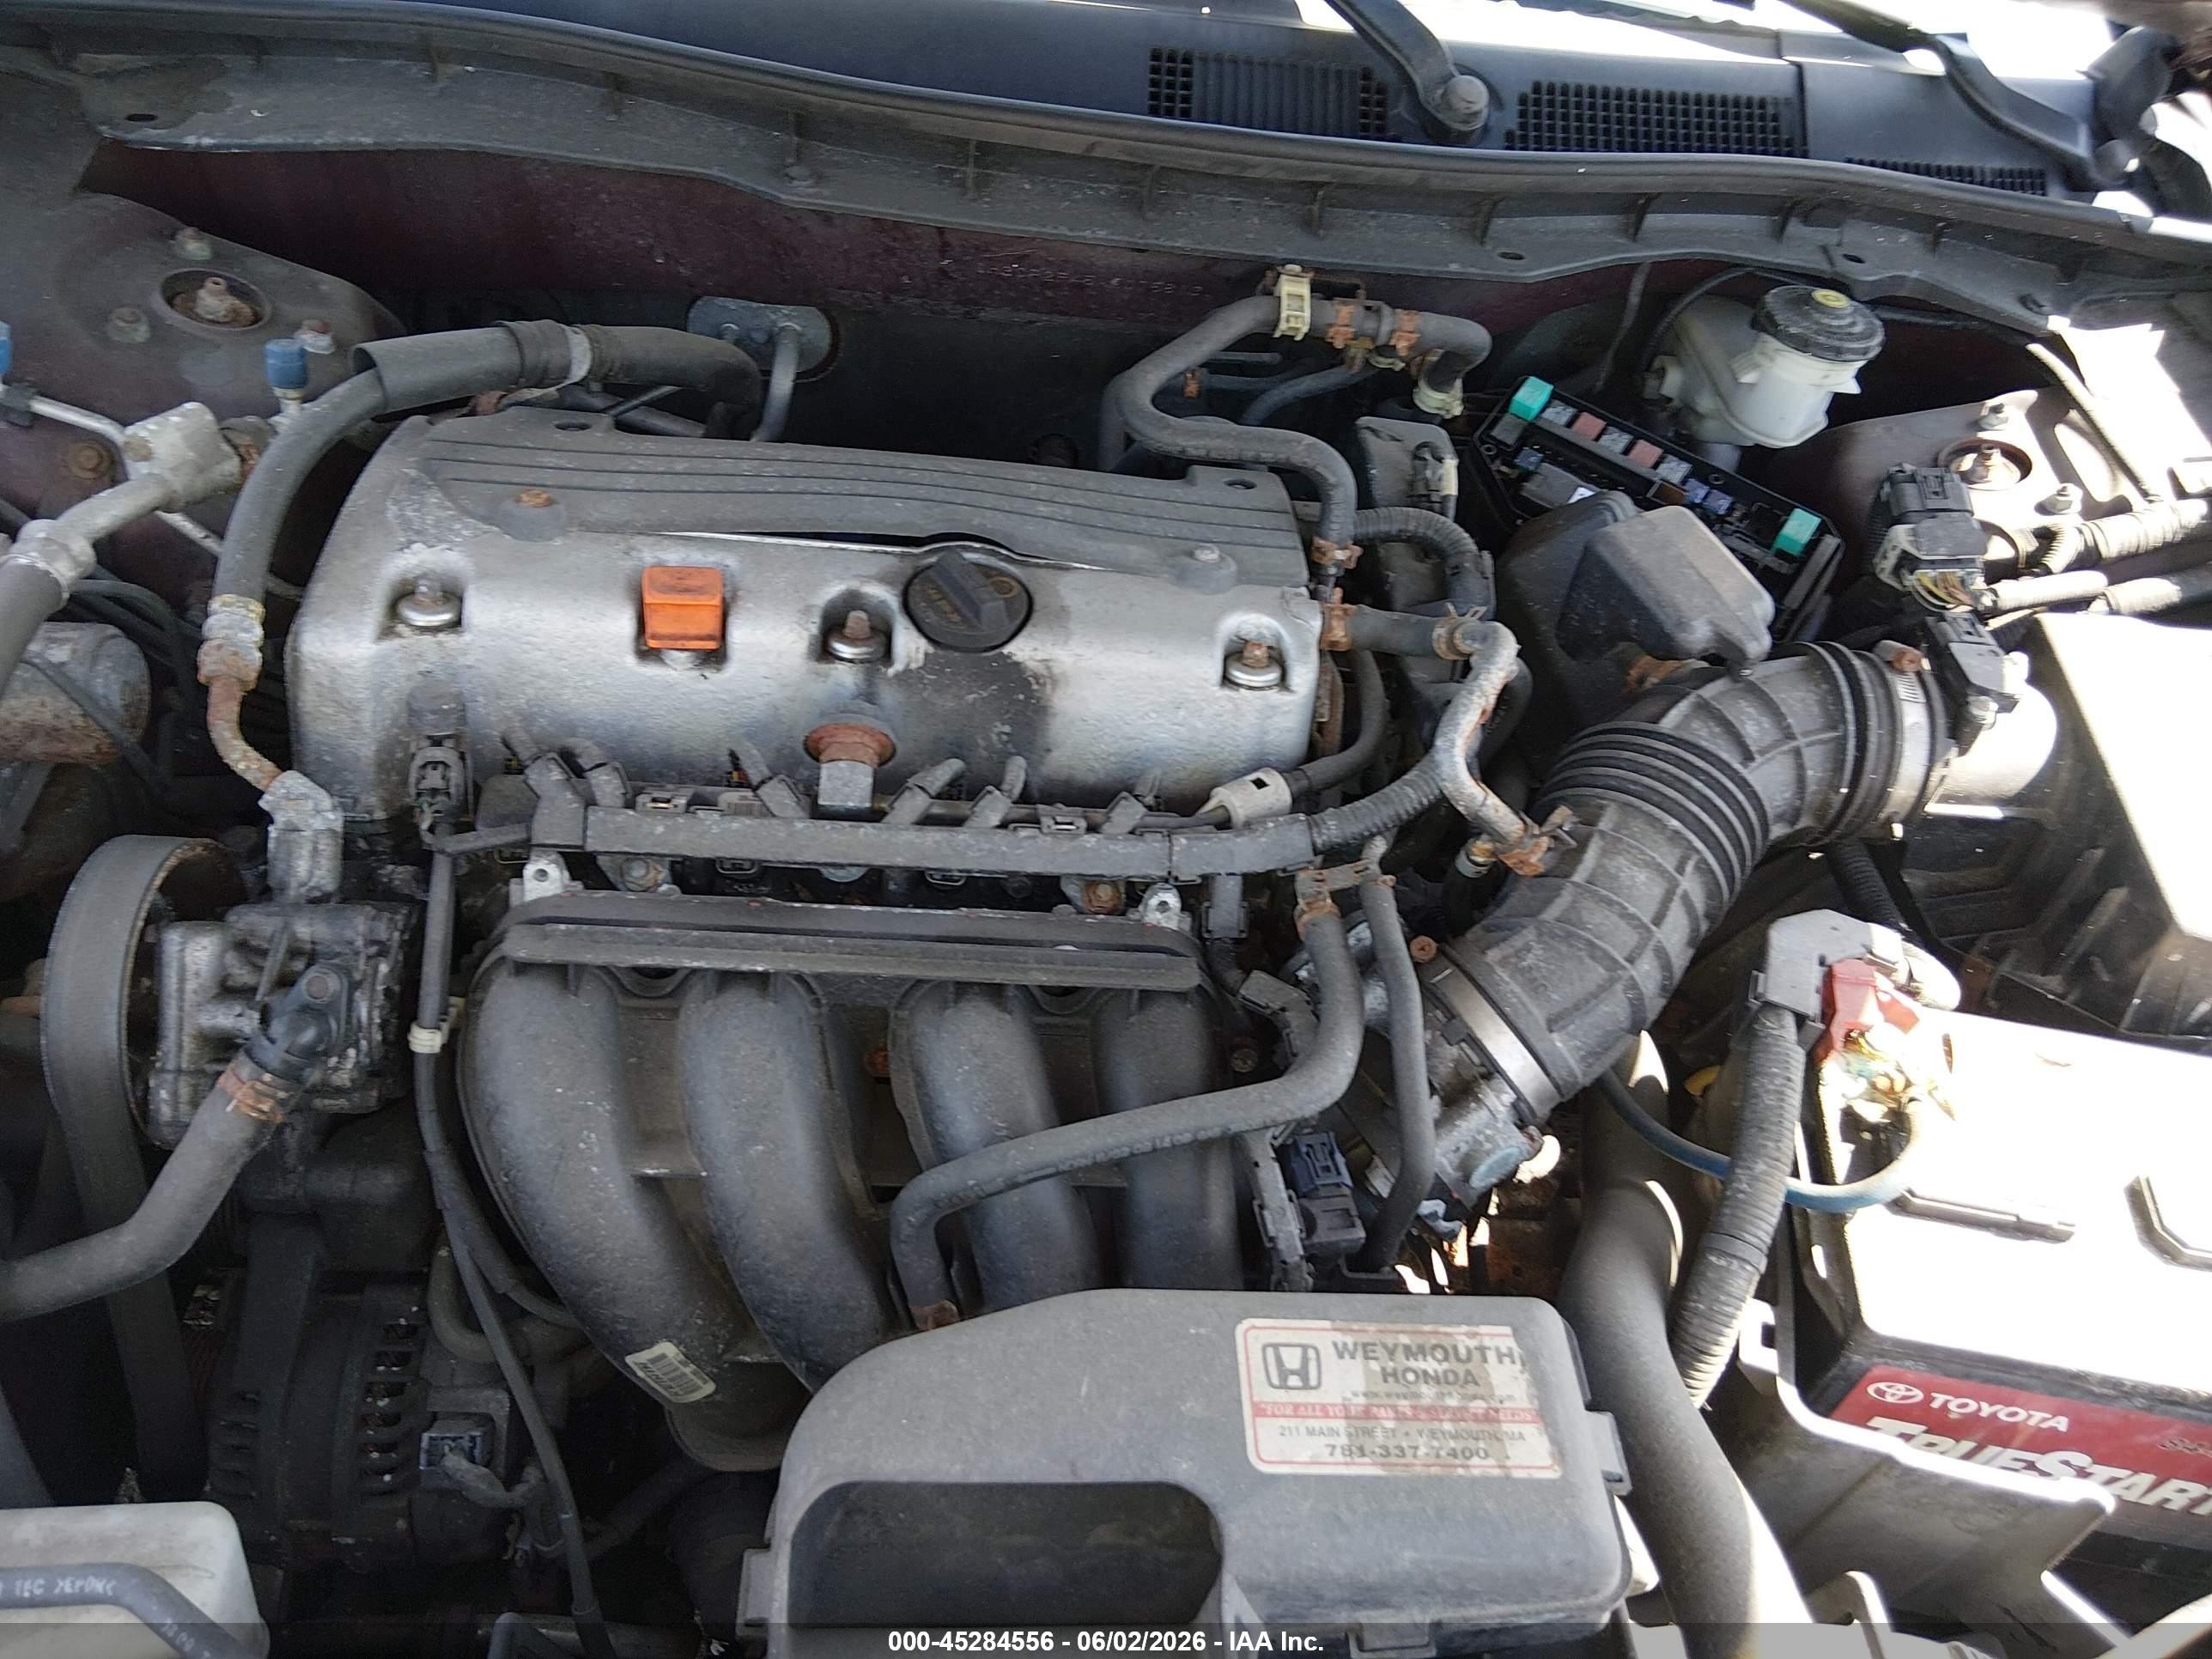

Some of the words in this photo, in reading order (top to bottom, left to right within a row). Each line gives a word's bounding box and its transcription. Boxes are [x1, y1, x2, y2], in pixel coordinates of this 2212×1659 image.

[1332, 1340, 1516, 1365] WEYMOUTH
[1381, 1366, 1481, 1388] HONDA
[1929, 1392, 2069, 1432] TOYOTA
[1279, 1425, 1302, 1437] 211
[1305, 1425, 1341, 1438] MAIN
[1345, 1426, 1397, 1440] STREET
